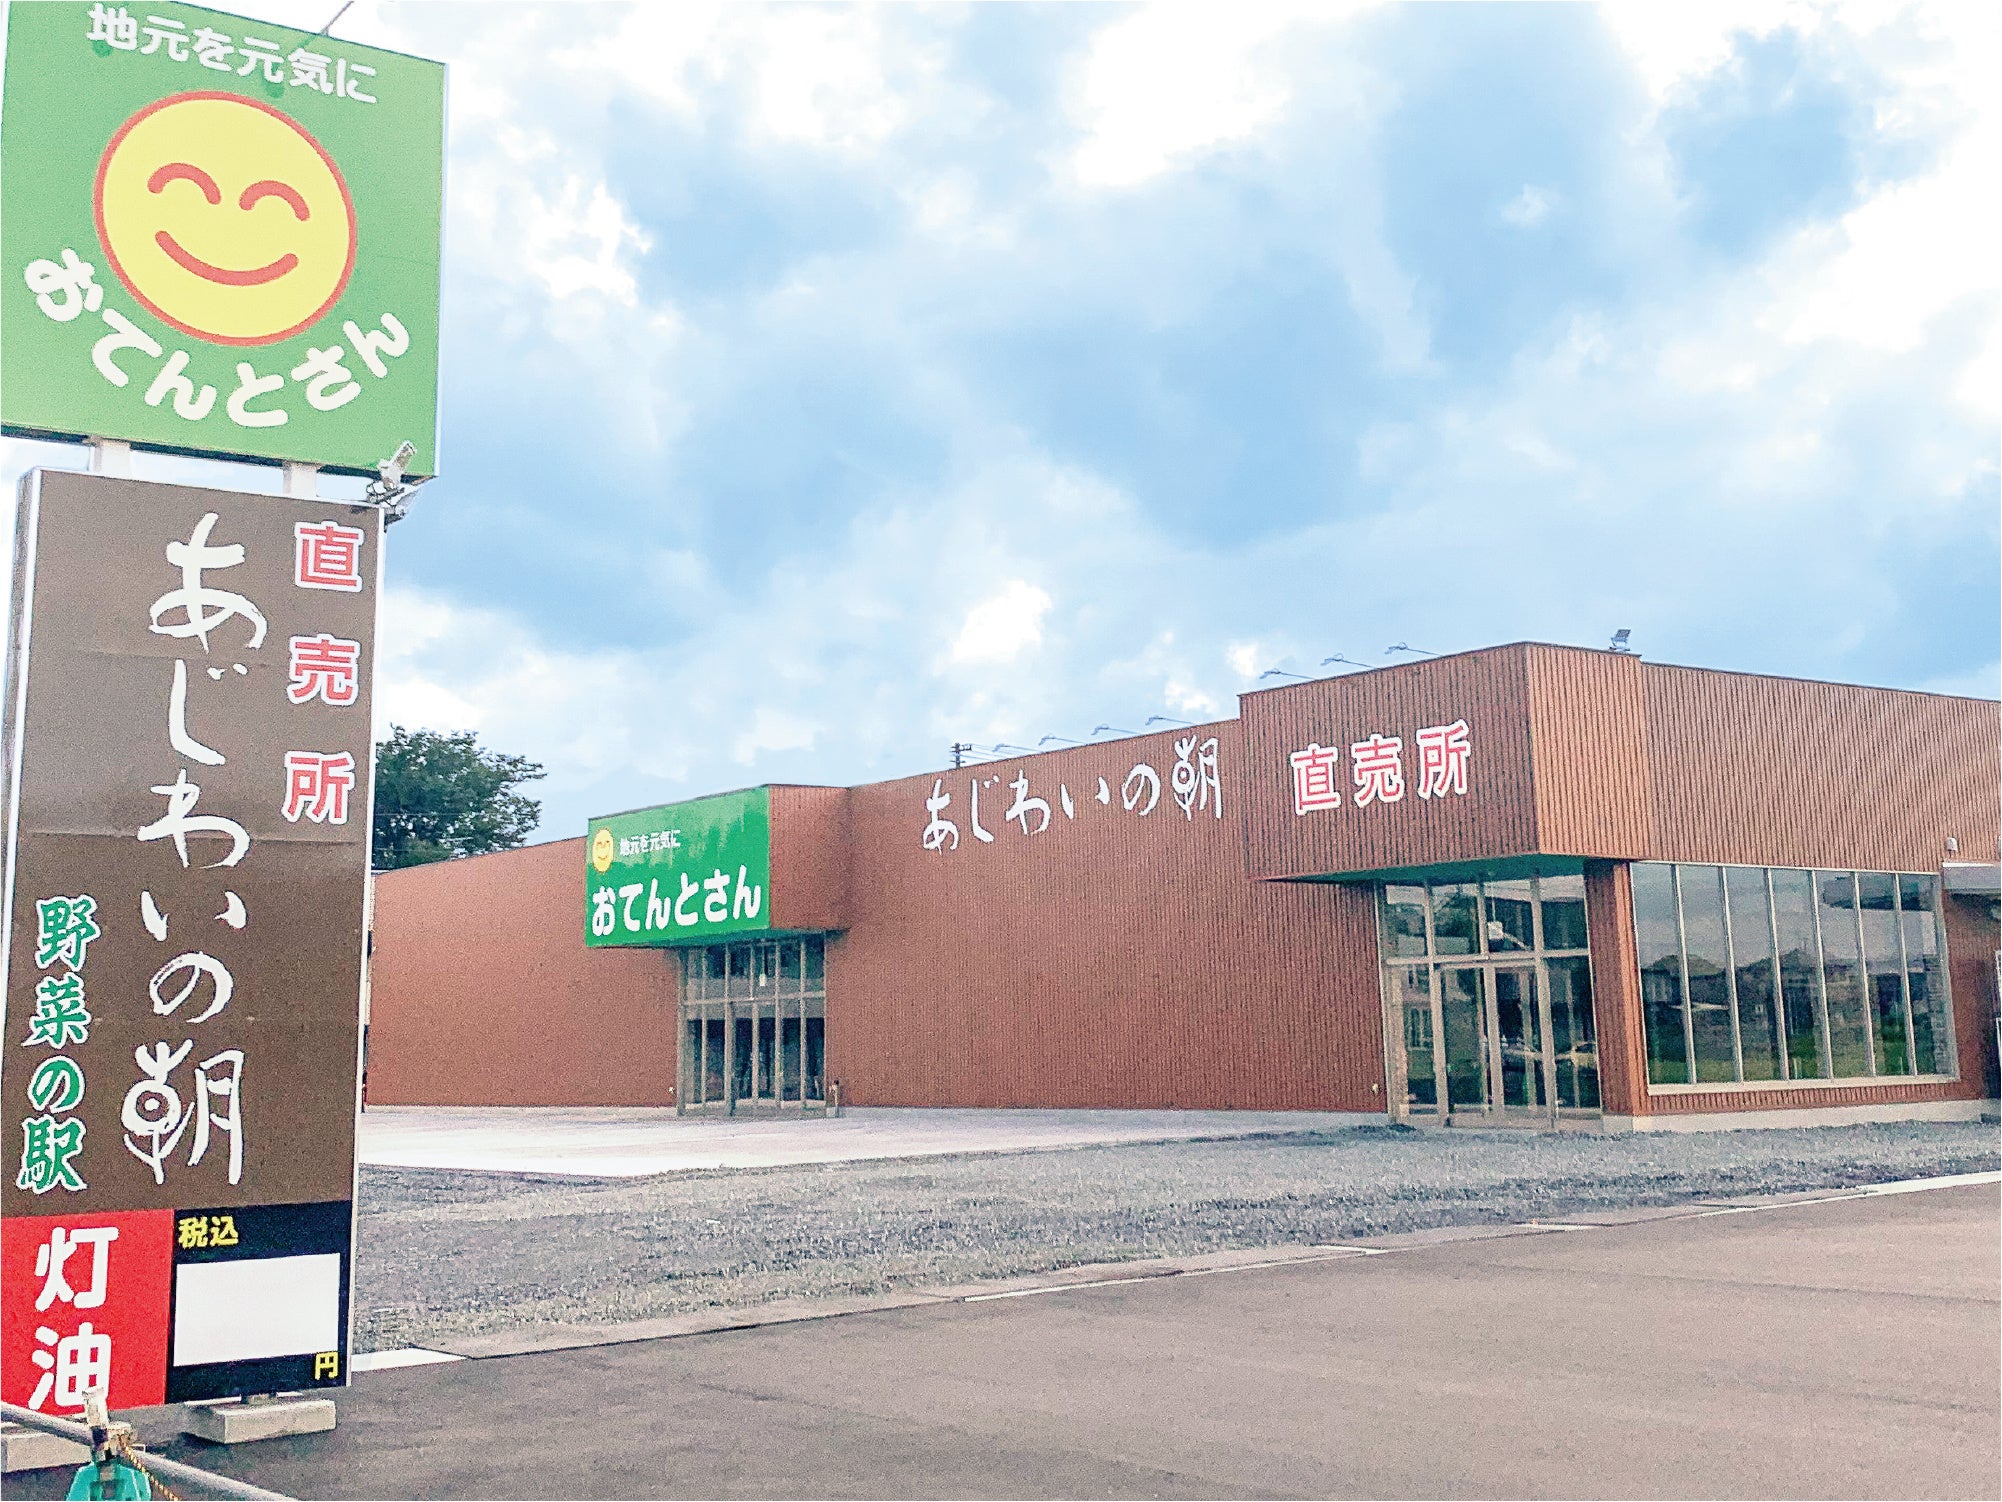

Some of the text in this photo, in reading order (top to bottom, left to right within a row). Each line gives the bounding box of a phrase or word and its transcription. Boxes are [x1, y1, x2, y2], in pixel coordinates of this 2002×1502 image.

[87, 4, 377, 103] 地元を元気に
[24, 248, 410, 427] おてんとさん
[281, 520, 365, 825] 直売所
[922, 734, 1222, 855] あじわいの朝
[1290, 718, 1471, 815] 直売所
[121, 512, 269, 1185] あじわいの朝
[592, 864, 761, 937] おてんとさん
[16, 895, 100, 1194] 野菜の駅
[178, 1216, 239, 1249] 税込
[28, 1226, 119, 1410] 灯油
[315, 1351, 338, 1380] 円
